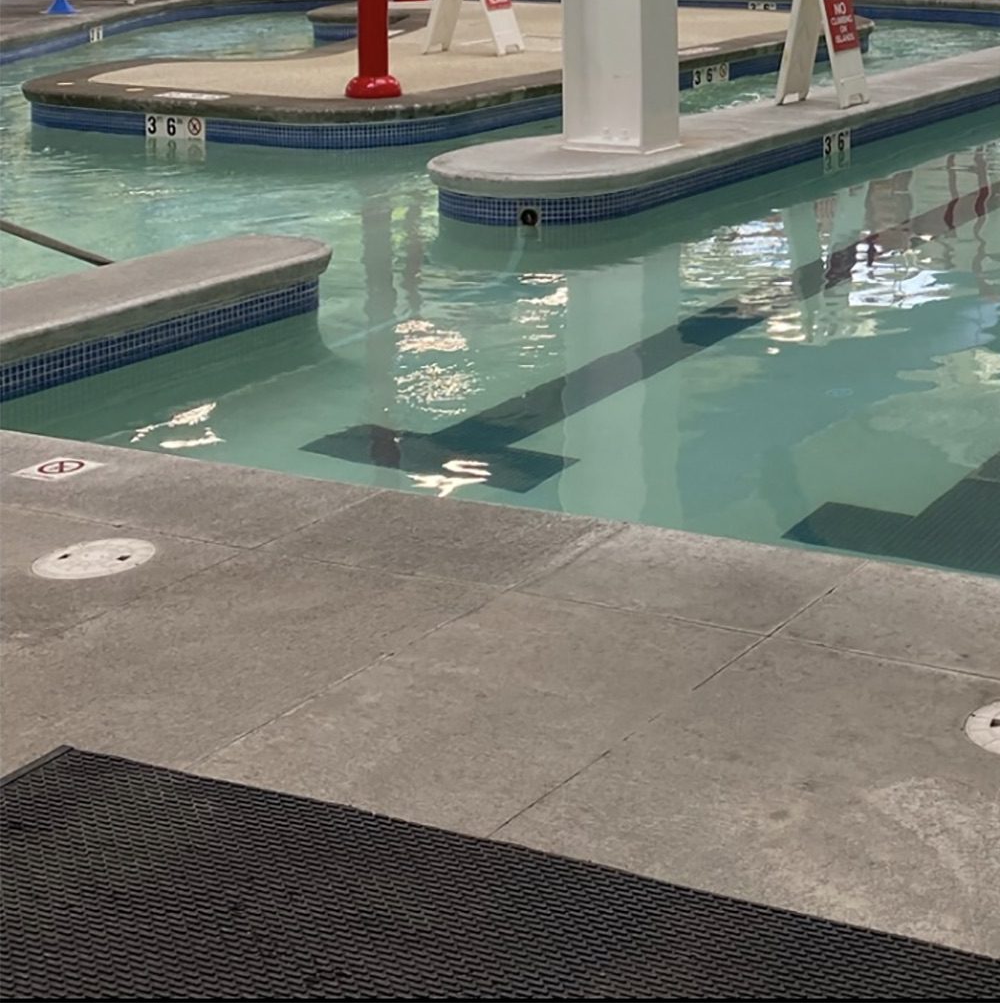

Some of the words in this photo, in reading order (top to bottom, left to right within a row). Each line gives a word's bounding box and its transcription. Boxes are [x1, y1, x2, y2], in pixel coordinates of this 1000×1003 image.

[833, 2, 847, 15] NO
[695, 70, 701, 85] 3
[706, 67, 713, 82] 6
[147, 116, 157, 134] 3
[167, 117, 176, 136] 6
[825, 136, 831, 155] 3
[838, 132, 845, 151] 6
